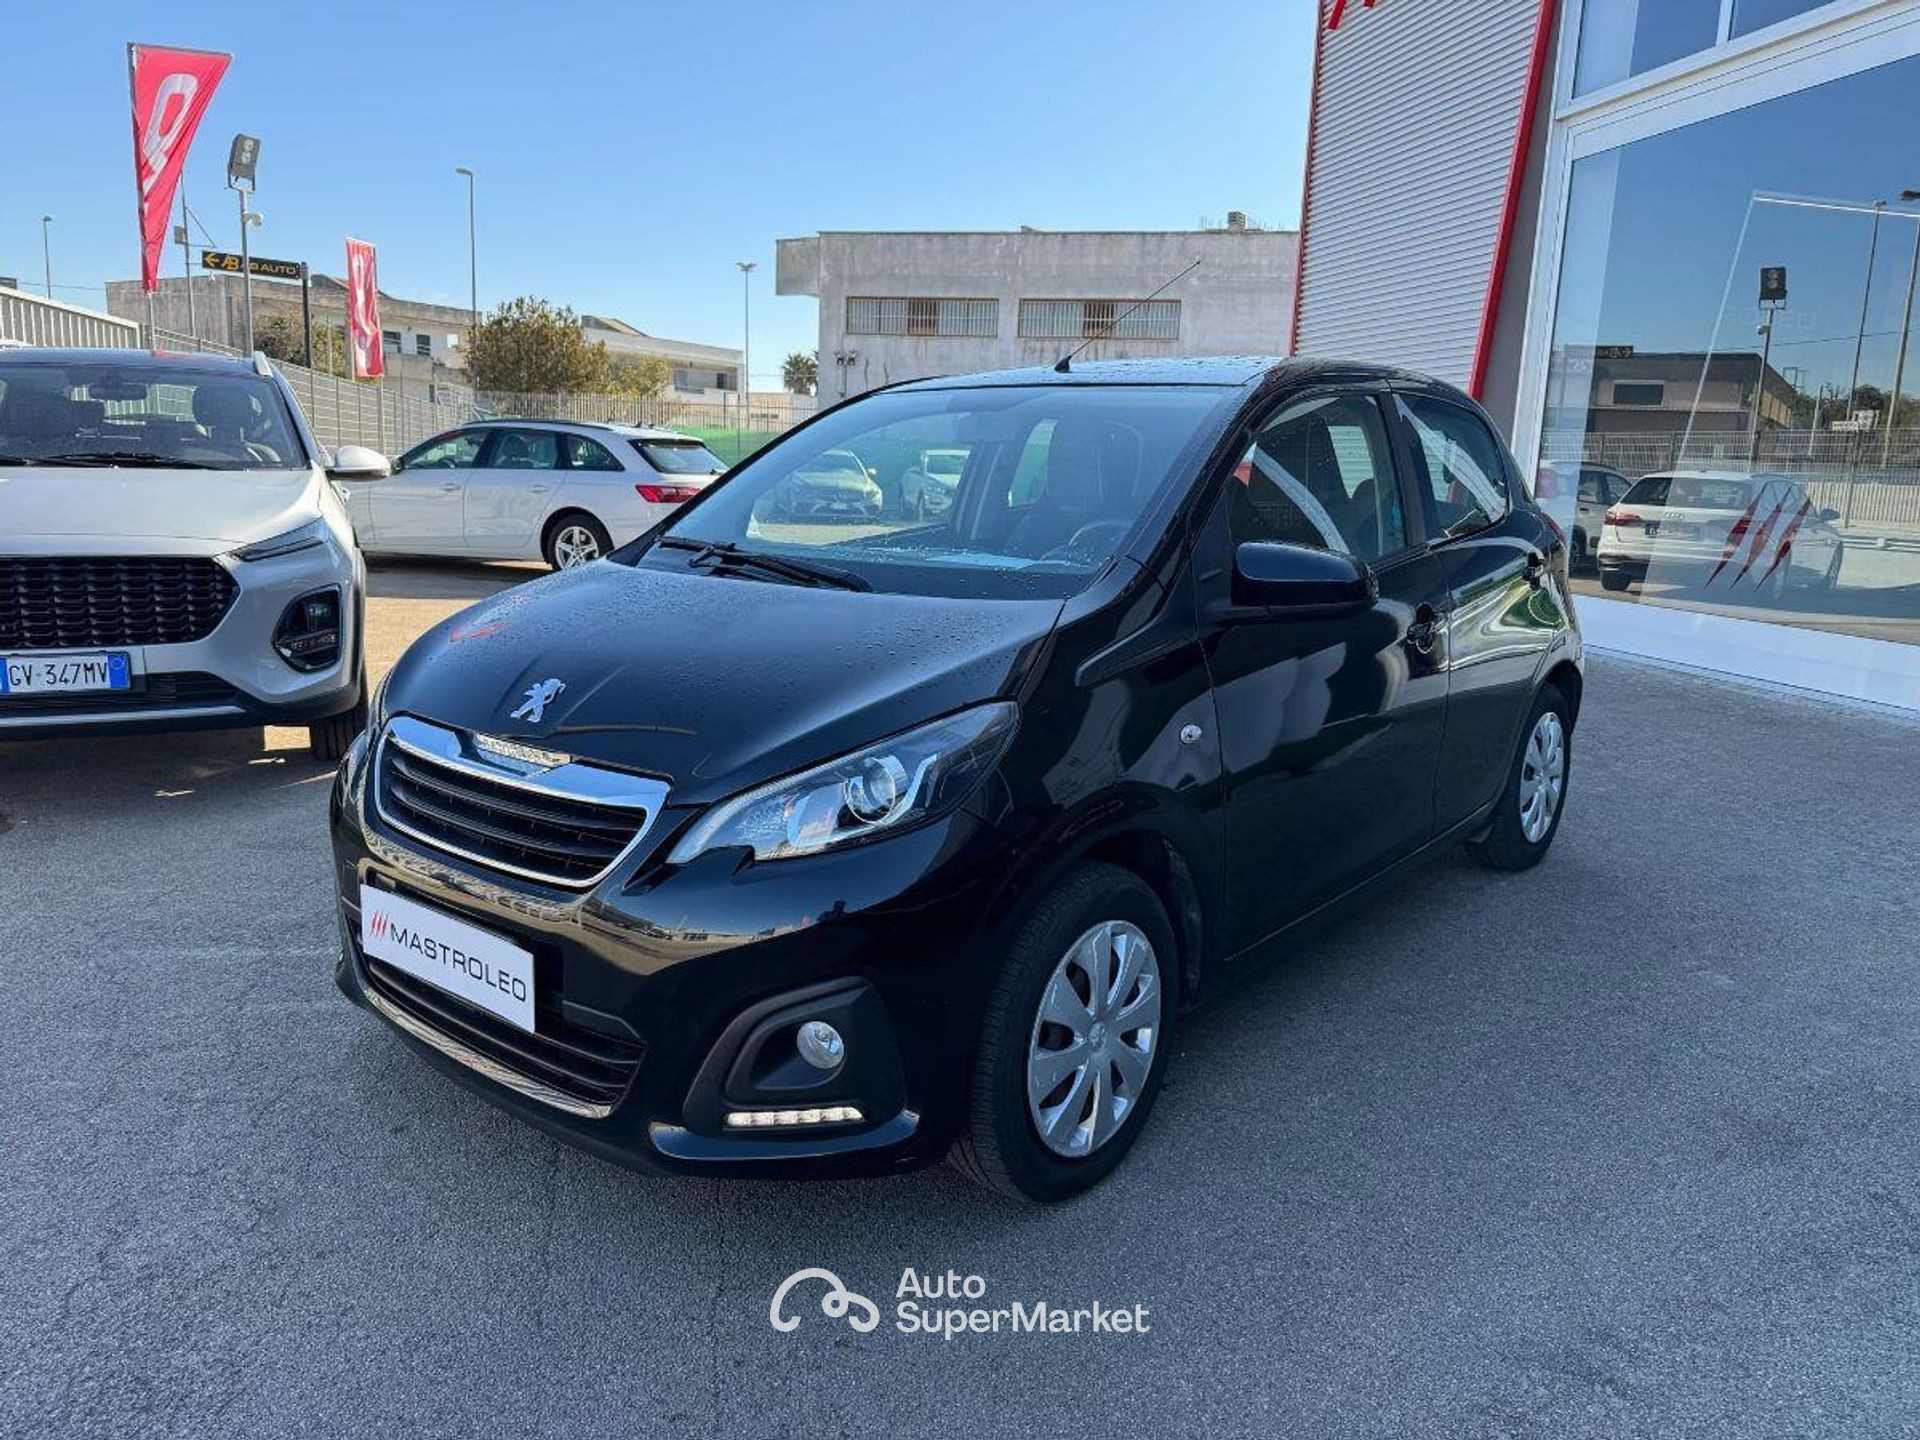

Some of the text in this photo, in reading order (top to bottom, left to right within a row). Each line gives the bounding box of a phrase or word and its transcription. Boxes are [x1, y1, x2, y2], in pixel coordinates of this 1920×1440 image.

[260, 264, 296, 275] AUTO
[8, 662, 108, 686] GV 347MV
[389, 922, 527, 1002] MASTROLEO
